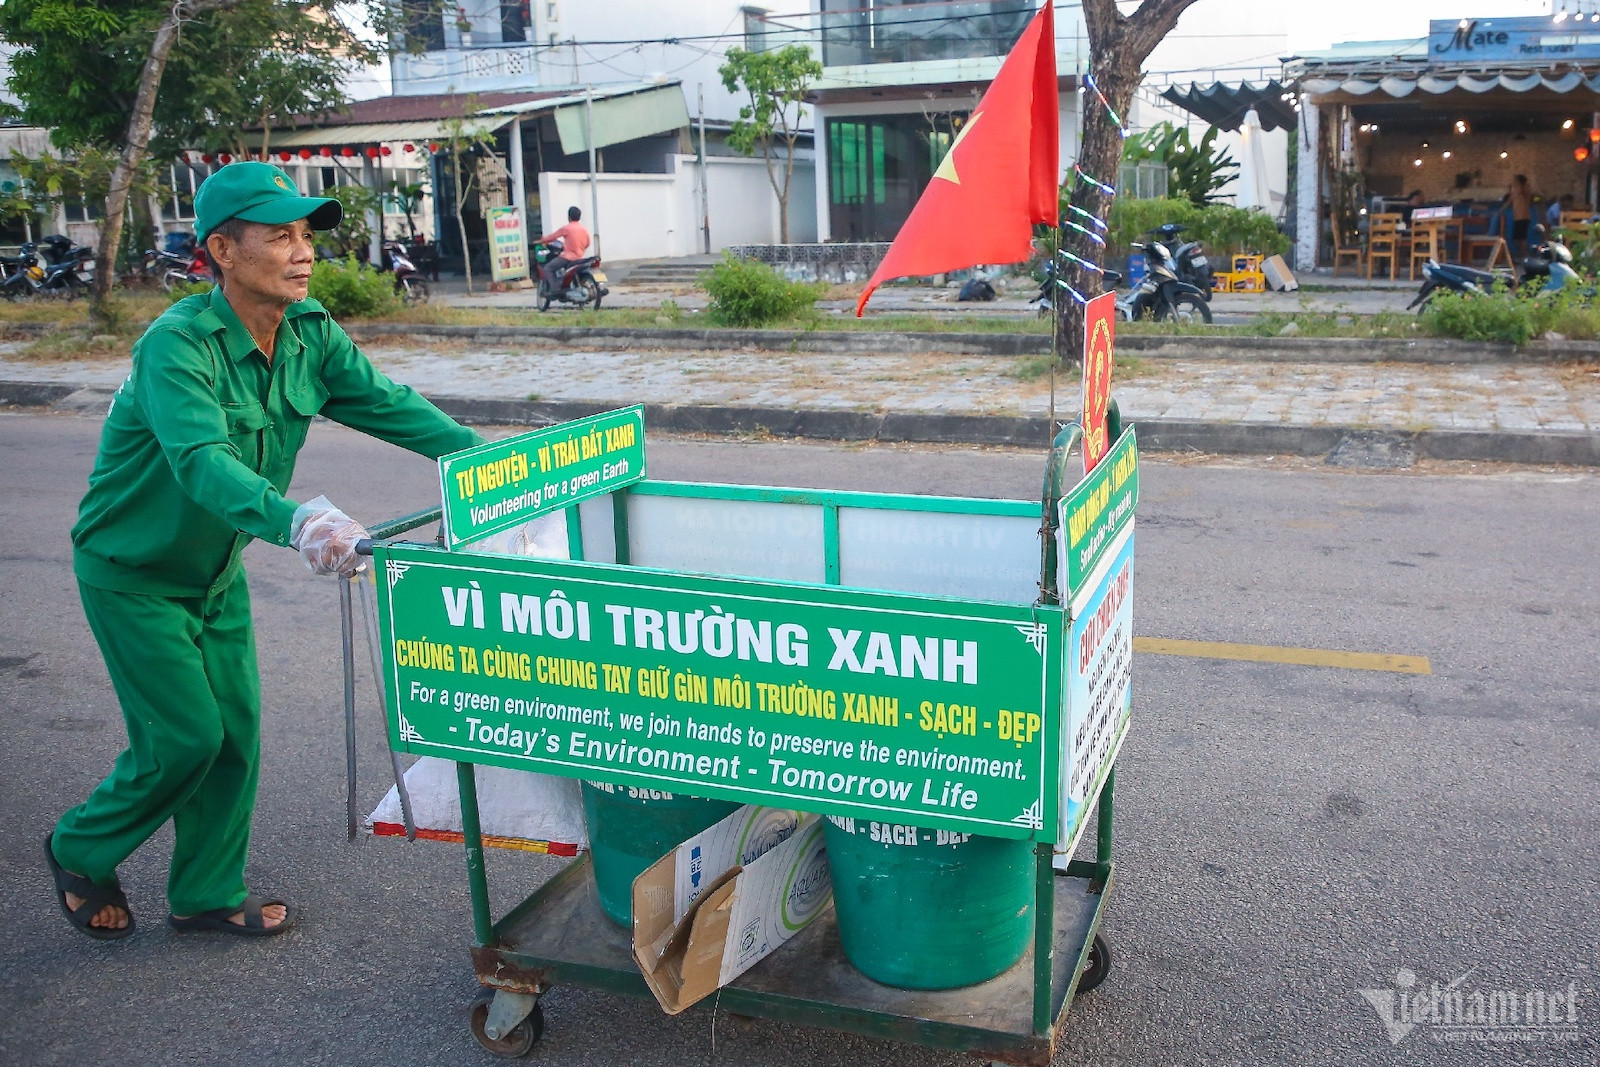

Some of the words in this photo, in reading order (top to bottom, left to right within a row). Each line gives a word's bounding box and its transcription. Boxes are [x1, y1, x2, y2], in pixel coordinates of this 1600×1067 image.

[1435, 20, 1508, 53] Mate
[456, 465, 474, 504] TỰ
[476, 450, 529, 494] NGUYỆN
[530, 461, 537, 469] -
[538, 441, 552, 473] VÌ
[552, 434, 580, 469] TRÁI
[582, 425, 603, 461] ĐẤT
[606, 423, 636, 454] XANH
[470, 490, 541, 528] Volunteering
[544, 482, 558, 501] for
[561, 481, 568, 495] a
[570, 469, 600, 496] green
[602, 458, 629, 481] Earth
[441, 580, 485, 629] VÌ
[500, 590, 591, 642] MÔI
[605, 603, 809, 667] TRƯỜNG
[827, 627, 978, 685] XANH
[396, 636, 454, 672] CHÚNG
[458, 646, 479, 675] TA
[483, 644, 531, 681] CÙNG
[536, 655, 597, 690] CHUNG
[602, 663, 631, 694] TAY
[637, 664, 671, 699] GIỮ
[674, 668, 707, 704] GÌN
[713, 673, 751, 710] MÔI
[756, 679, 836, 720] TRƯỜNG
[842, 692, 899, 727] XANH
[919, 700, 977, 739] SẠCH
[983, 721, 992, 729] -
[997, 709, 1042, 748] ĐẸP
[410, 681, 437, 703] For
[439, 689, 449, 706] a
[454, 690, 500, 716] green
[504, 696, 614, 731] environment,
[619, 712, 644, 732] we
[647, 712, 681, 739] join
[686, 716, 742, 747] hands
[747, 726, 766, 749] to
[769, 732, 854, 759] preserve
[859, 740, 890, 764] the
[895, 746, 1027, 780] environment.
[448, 725, 458, 733] -
[568, 731, 740, 780] Environment
[748, 767, 758, 775] -
[767, 758, 913, 802] Tomorrow
[921, 778, 979, 811] Life
[869, 821, 918, 849] SẠCH
